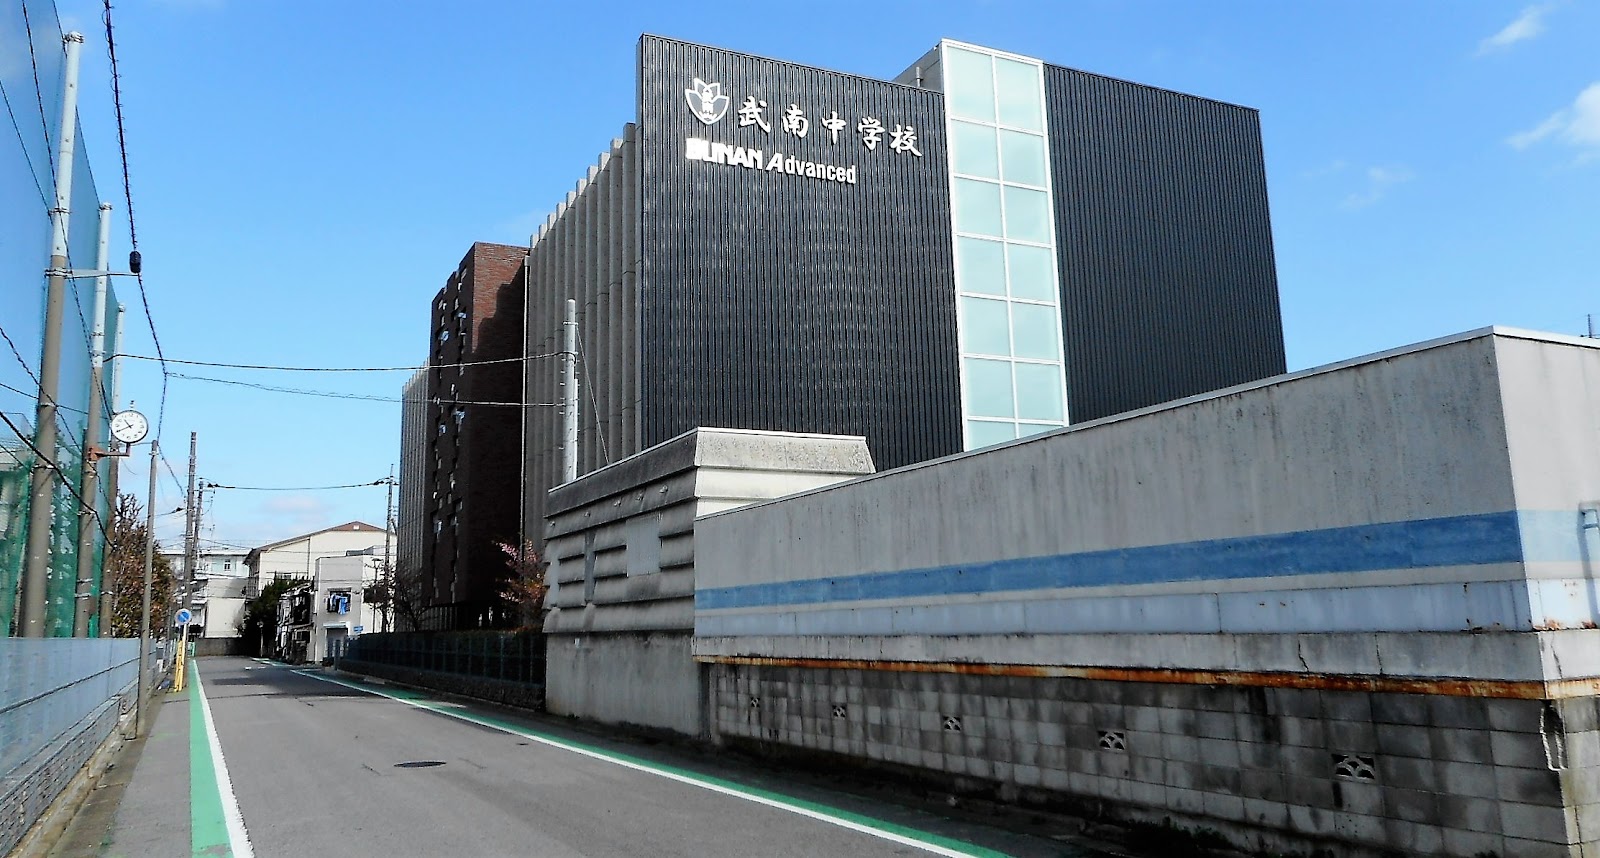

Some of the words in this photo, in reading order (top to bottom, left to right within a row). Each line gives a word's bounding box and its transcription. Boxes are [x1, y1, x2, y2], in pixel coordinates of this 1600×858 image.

[738, 96, 922, 157] 武南中学校
[765, 152, 856, 184] Advanced
